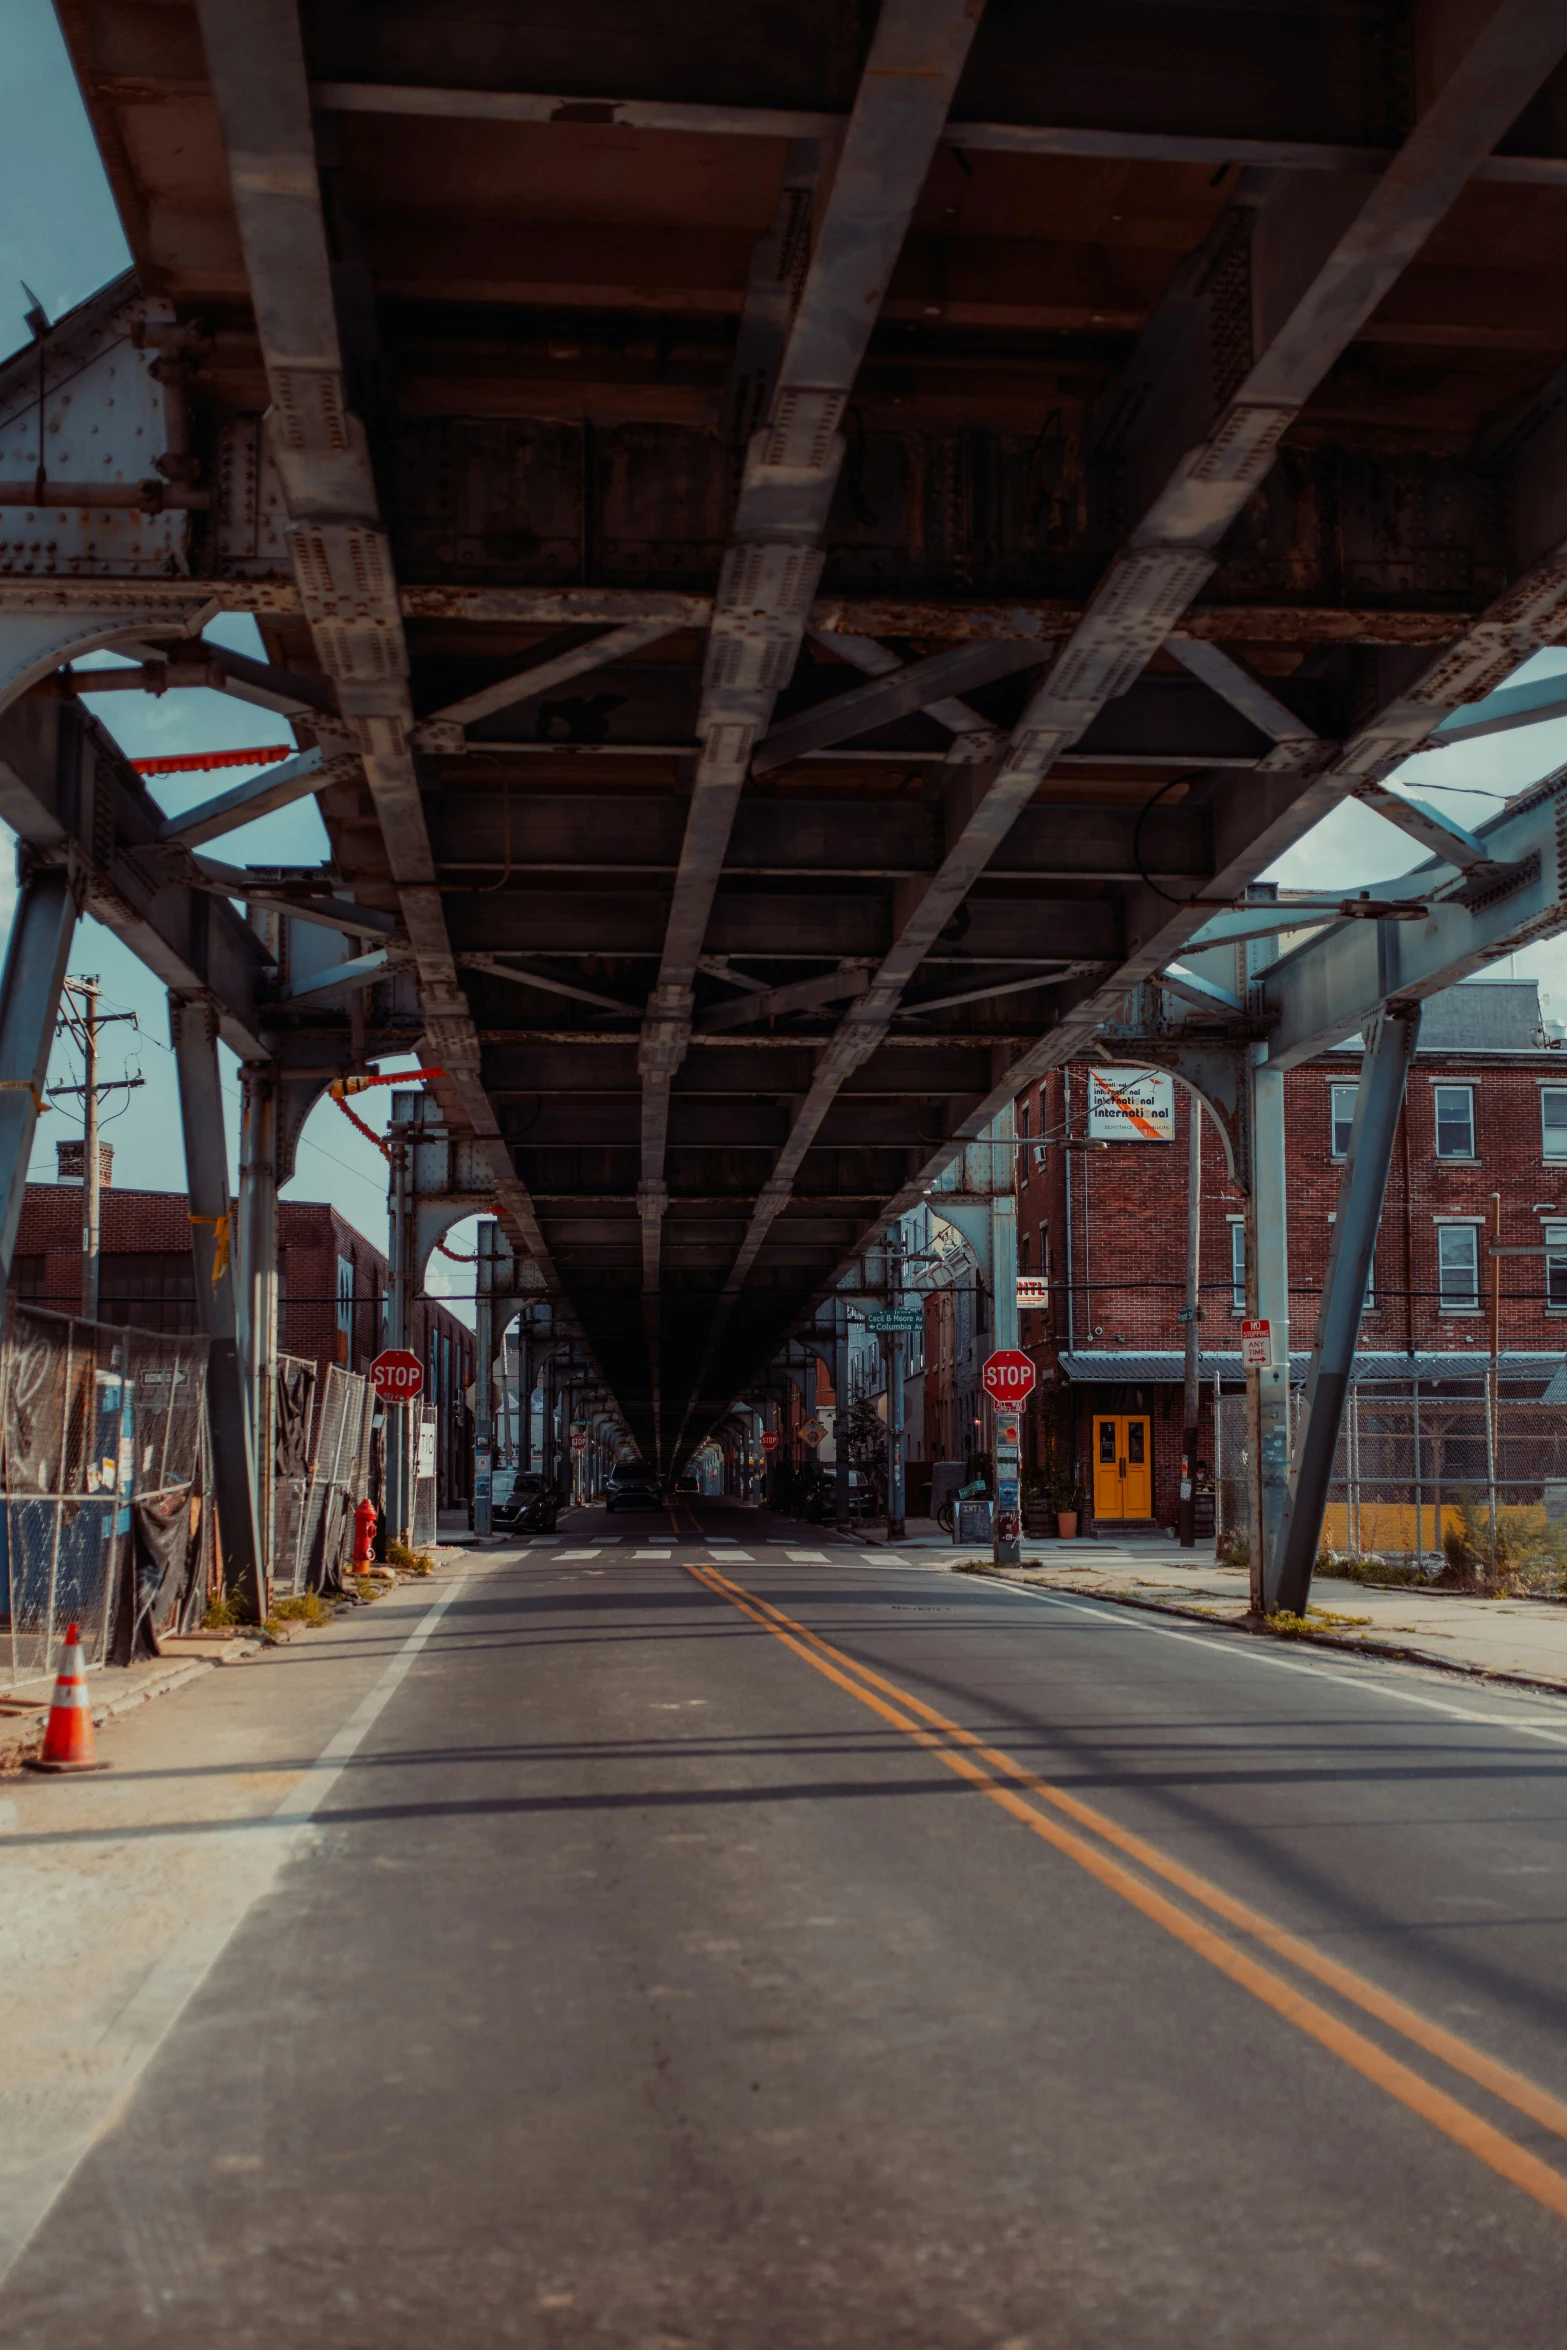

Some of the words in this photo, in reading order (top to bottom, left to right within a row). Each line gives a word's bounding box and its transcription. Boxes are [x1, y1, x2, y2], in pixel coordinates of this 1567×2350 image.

[868, 1314, 884, 1322] Cecil
[1250, 1321, 1261, 1331] NO
[1243, 1330, 1269, 1338] STOPPING
[373, 1365, 420, 1387] STOP
[986, 1365, 1032, 1386] STOP
[571, 1438, 587, 1446] STOP
[962, 1504, 985, 1513] INTL
